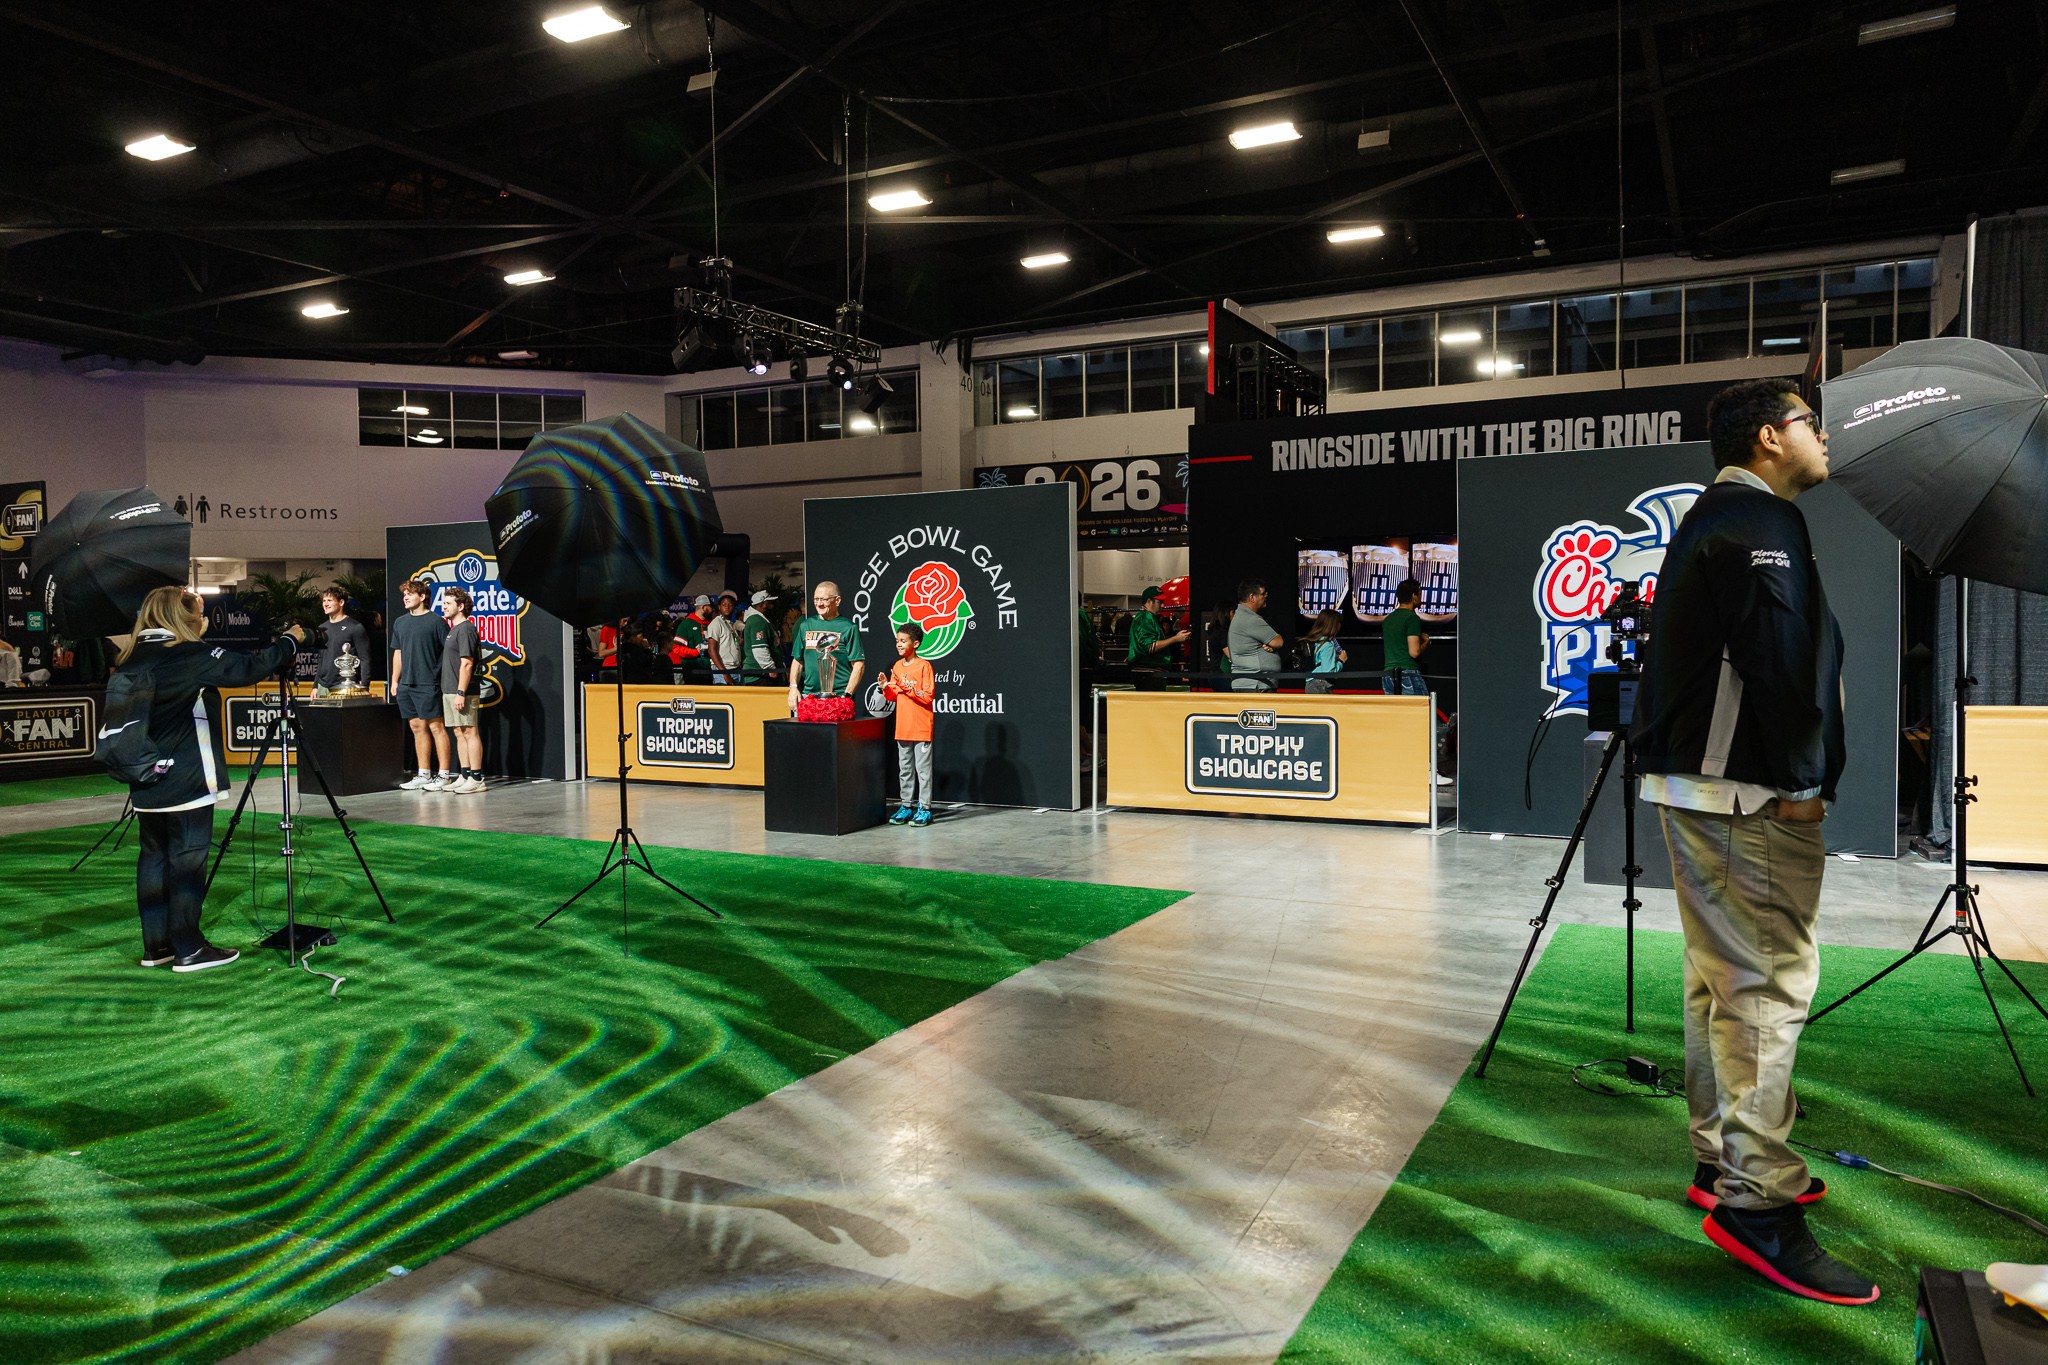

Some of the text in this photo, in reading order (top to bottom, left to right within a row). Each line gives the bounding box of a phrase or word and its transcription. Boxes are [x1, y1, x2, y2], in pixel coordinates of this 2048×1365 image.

[960, 376, 972, 392] 40
[1874, 387, 1946, 412] Profoto
[1844, 412, 1882, 429] Umbrella
[1884, 402, 1920, 415] Shallow
[1272, 410, 1681, 472] RINGSIDE WITH THE BIG RING
[662, 472, 699, 486] Profoto
[16, 514, 34, 526] FAN
[220, 504, 338, 520] Restrooms
[505, 510, 532, 534] Profoto
[1751, 550, 1788, 559] Florida
[1752, 557, 1773, 566] Blue
[852, 525, 1018, 632] ROSE BOWL GAME
[8, 586, 22, 595] DELL
[430, 585, 509, 612] Atate
[228, 612, 250, 626] Modelo
[478, 614, 522, 658] BOWL
[296, 652, 313, 664] ART
[295, 664, 318, 676] GAME
[953, 670, 965, 686] by
[17, 708, 70, 719] PLAYOFF
[13, 717, 74, 742] FAN
[657, 718, 713, 735] TROPHY
[18, 740, 70, 750] CENTRAL
[646, 736, 725, 755] SHOWCASE
[1216, 734, 1304, 757] TROPHY
[1200, 757, 1322, 782] SHOWCASE
